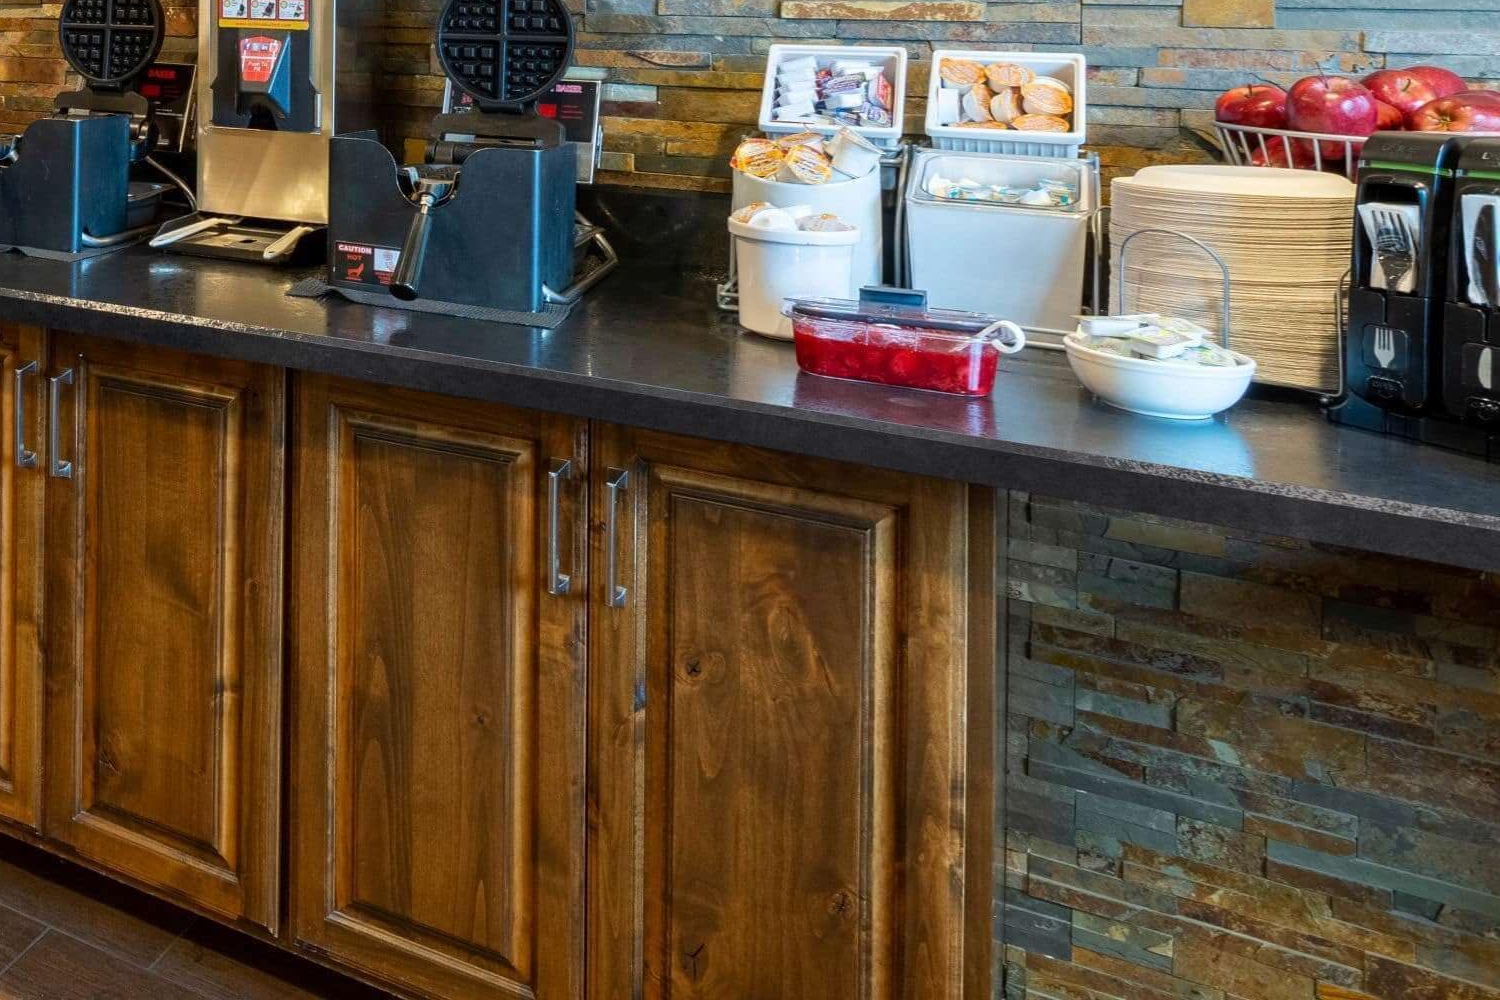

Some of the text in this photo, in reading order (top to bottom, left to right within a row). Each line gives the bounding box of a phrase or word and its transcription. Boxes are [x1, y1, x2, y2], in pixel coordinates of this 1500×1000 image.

[555, 84, 582, 94] BAKER
[338, 244, 373, 255] CAUTION
[347, 253, 363, 261] HOT
